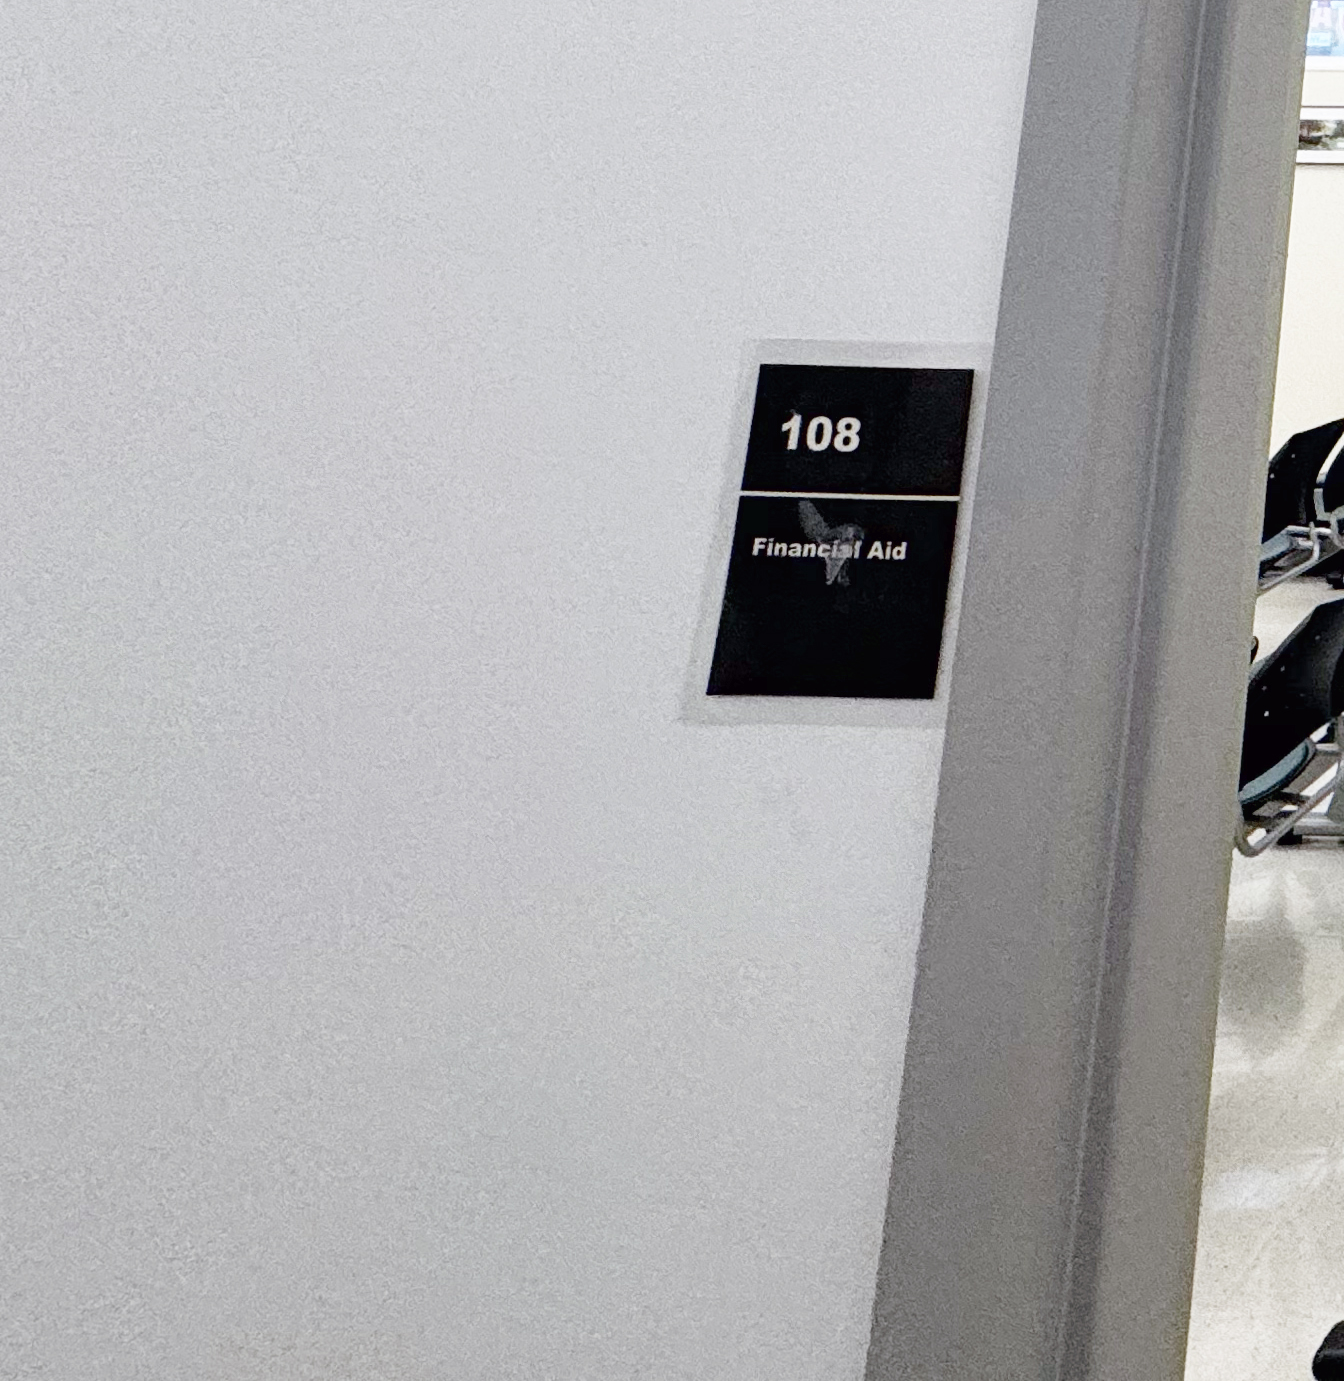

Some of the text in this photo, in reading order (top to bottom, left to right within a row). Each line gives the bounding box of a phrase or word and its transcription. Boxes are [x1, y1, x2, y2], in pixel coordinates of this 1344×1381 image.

[781, 414, 862, 453] 108
[752, 537, 907, 561] Financial Aid
